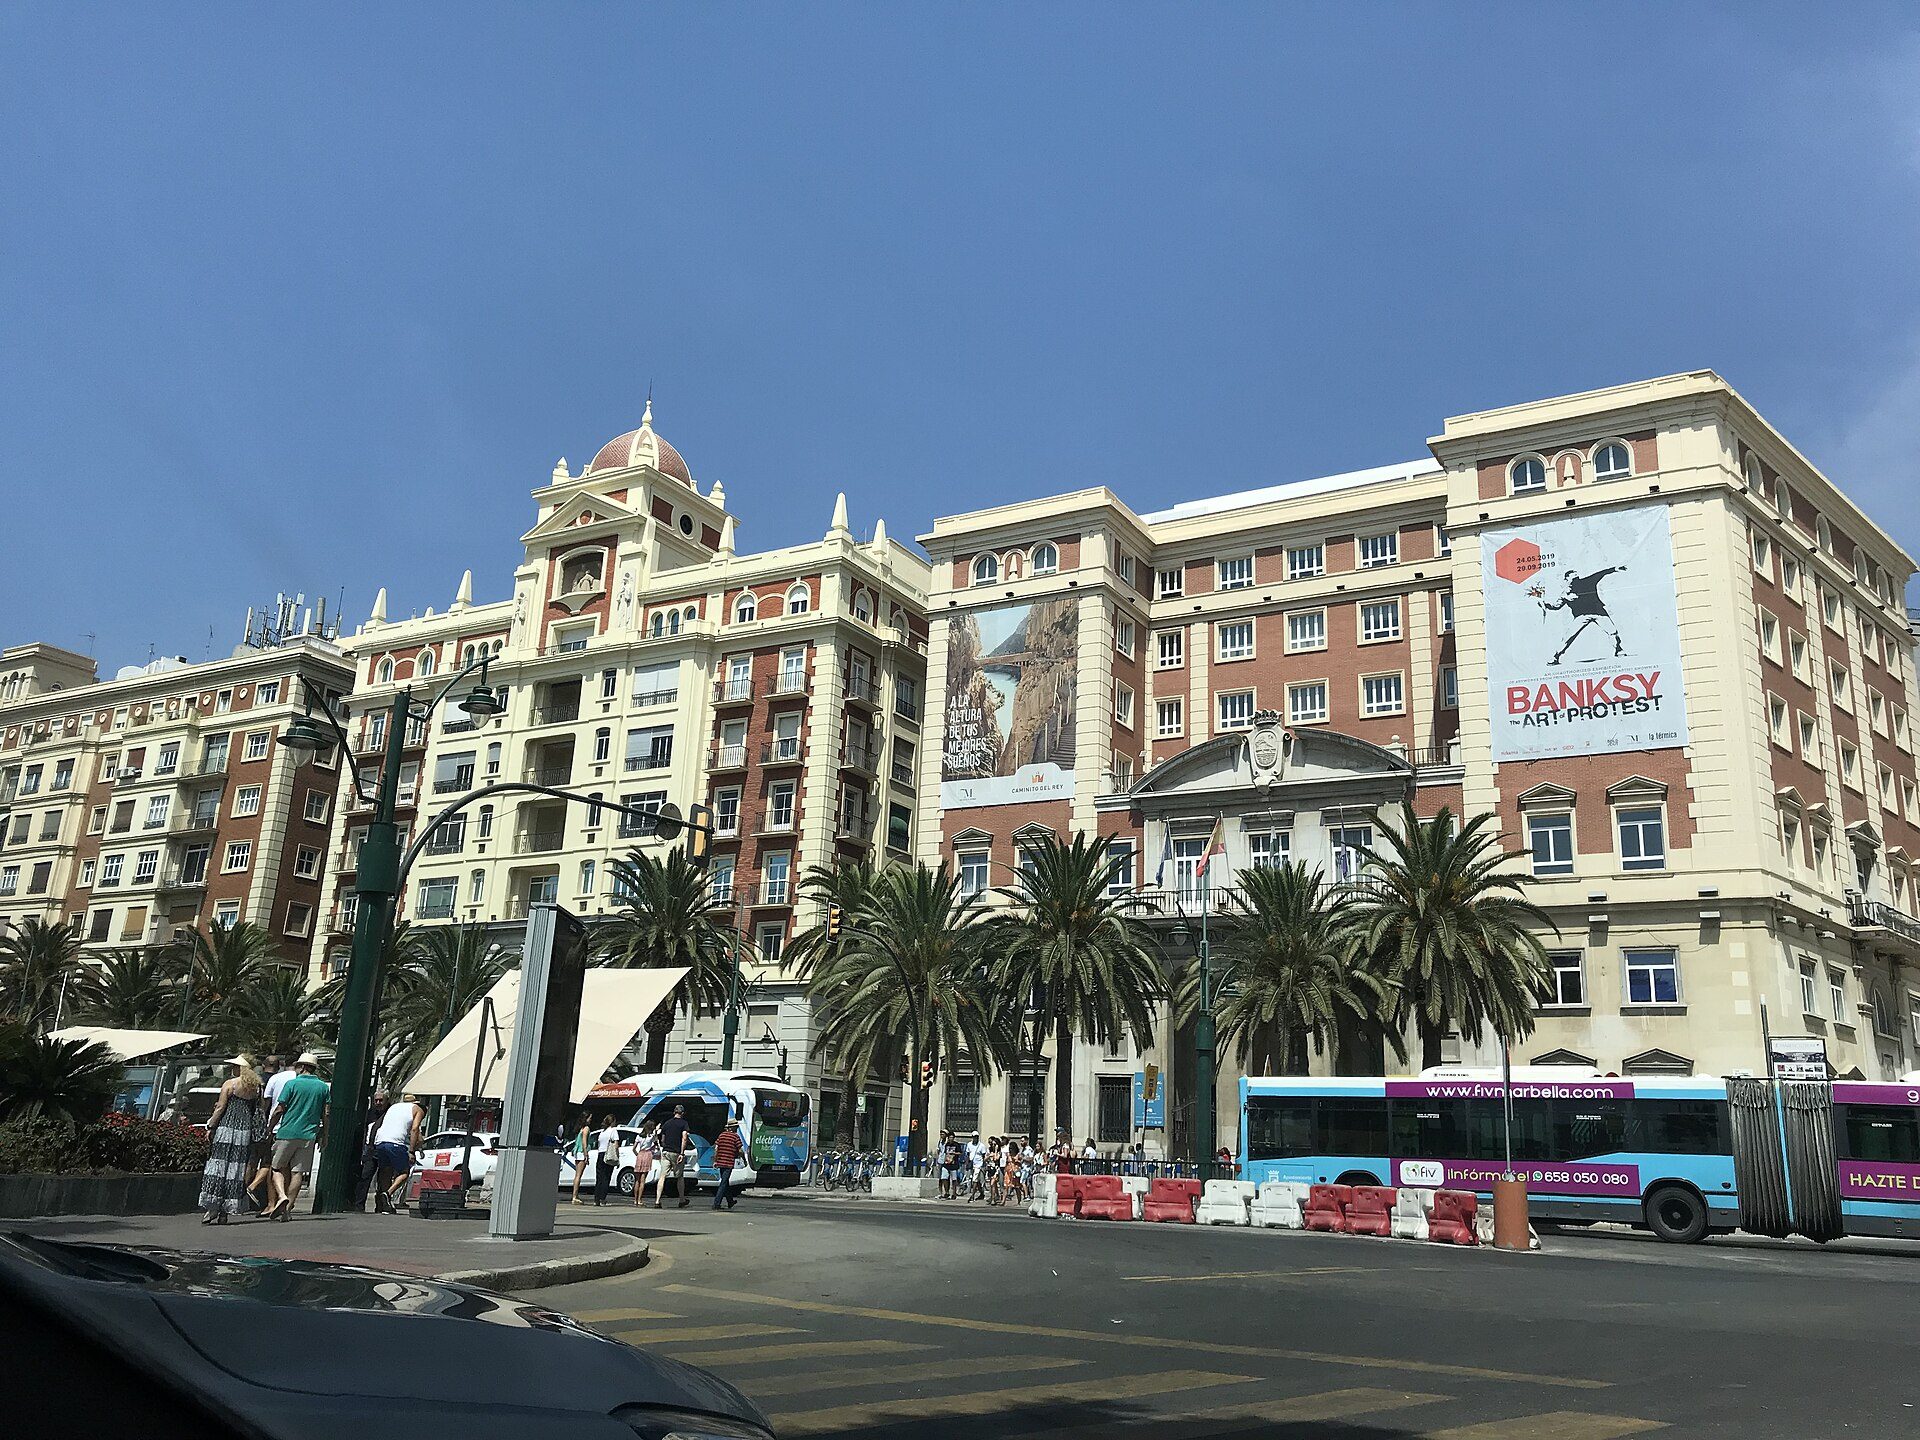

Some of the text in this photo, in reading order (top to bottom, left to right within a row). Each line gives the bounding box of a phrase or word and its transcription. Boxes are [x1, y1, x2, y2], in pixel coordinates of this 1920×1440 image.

[1517, 553, 1555, 564] 24.05.2019
[1507, 671, 1661, 715] BANKSY
[950, 695, 970, 708] A LA
[949, 707, 982, 723] ALTURA
[1523, 709, 1560, 728] ART
[1567, 694, 1663, 723] PROTEST
[948, 723, 978, 739] DE TUS
[1648, 731, 1678, 741] la térmica
[948, 737, 988, 754] MEJORES
[1011, 786, 1039, 794] CAMINITO
[1426, 1084, 1614, 1099] www.fivmarbella.com
[755, 1135, 782, 1145] eléctrico
[1420, 1166, 1436, 1178] fiv
[1544, 1171, 1570, 1182] 658
[1573, 1172, 1599, 1184] 050
[1602, 1173, 1629, 1185] 080
[1849, 1173, 1907, 1189] HAZTE
